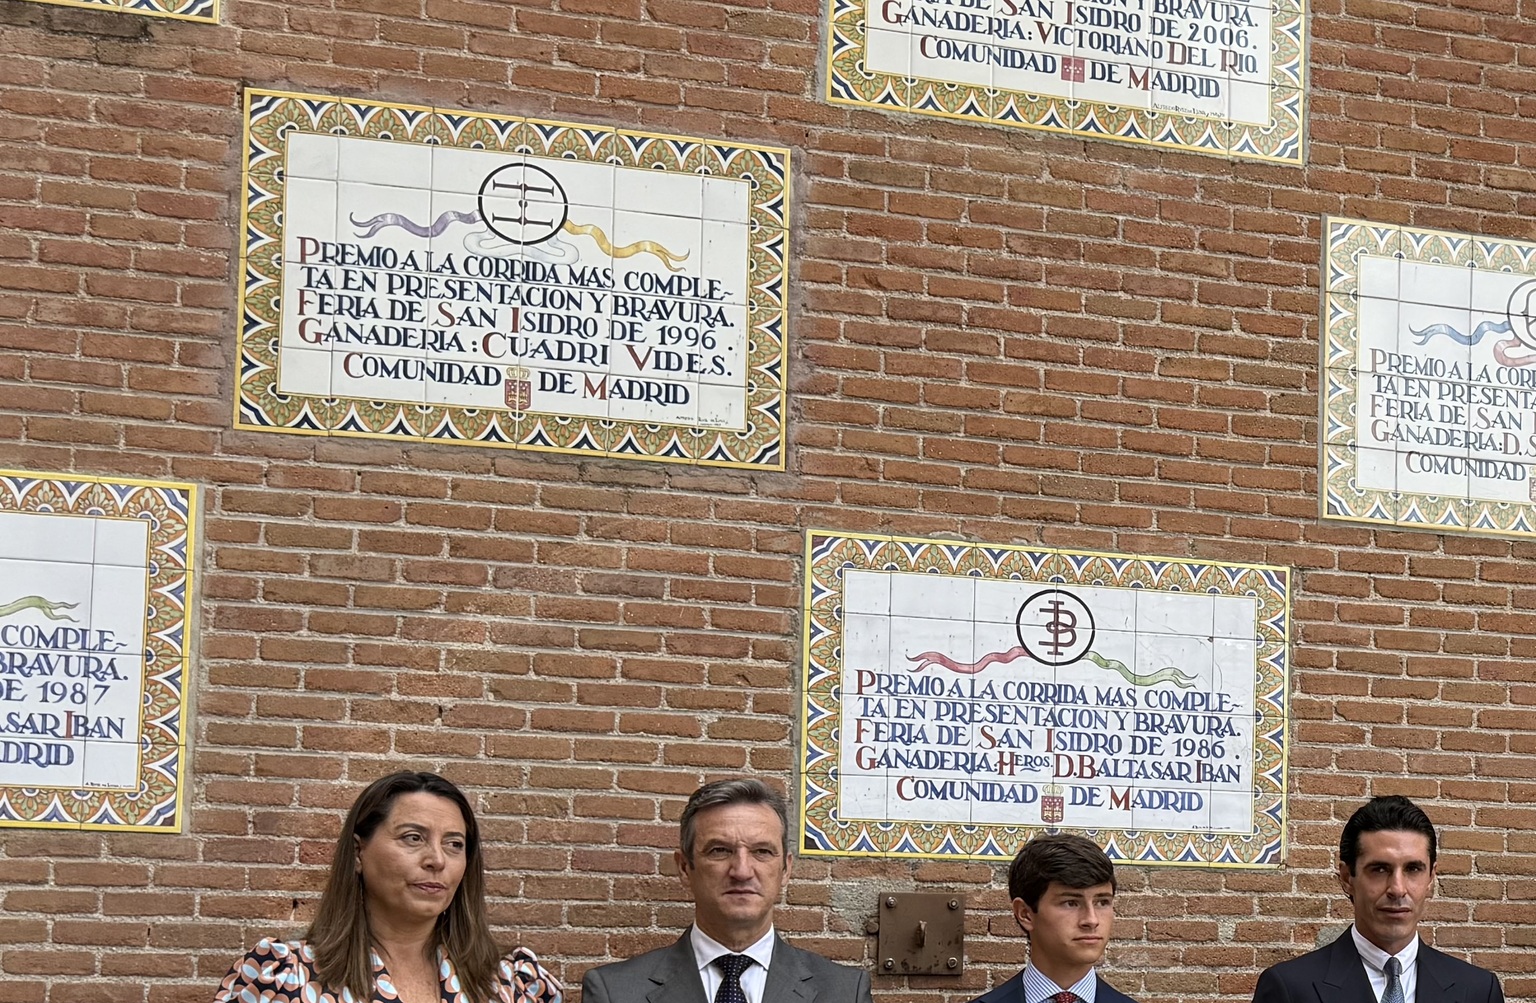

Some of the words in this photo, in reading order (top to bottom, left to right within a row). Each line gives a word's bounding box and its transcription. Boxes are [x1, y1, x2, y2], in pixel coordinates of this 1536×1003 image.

[1063, 0, 1141, 33] ISIDRO
[1148, 16, 1181, 39] DE
[919, 34, 1056, 75] COMUNIDAD
[1089, 60, 1123, 84] DE
[1127, 63, 1220, 97] MADRID
[1034, 20, 1163, 60] VICTORIANO
[1165, 39, 1216, 68] DEL
[296, 235, 399, 269] PREMIO
[398, 248, 421, 271] A
[425, 251, 459, 275] LA
[463, 254, 560, 284] CORRIDA
[568, 264, 614, 289] MAS
[296, 288, 382, 320] FERIA
[385, 299, 426, 324] DE
[432, 300, 498, 330] SAN
[509, 307, 598, 339] ISIDRO
[608, 319, 648, 344] DE
[299, 265, 332, 290] TA
[342, 269, 378, 294] EN
[386, 273, 582, 313] PRESENTACION
[582, 291, 606, 315] Y
[612, 294, 735, 327] BRAVURA.
[480, 330, 609, 367] CUADRI
[622, 342, 733, 377] VIDES.
[342, 351, 502, 390] COMUNIDAD
[538, 370, 578, 396] DE
[581, 371, 690, 405] MADRID
[1405, 450, 1525, 482] COMUNIDAD
[36, 681, 111, 705] 1987
[855, 718, 930, 744] FERIA
[935, 725, 970, 746] DE
[975, 724, 1033, 749] SAN
[1044, 727, 1122, 753] ISIDRO
[1128, 735, 1165, 755] DE
[895, 776, 1038, 805] COMUNIDAD
[1068, 786, 1104, 807] DE
[1108, 785, 1204, 811] MADRID
[1195, 760, 1241, 784] IBAN
